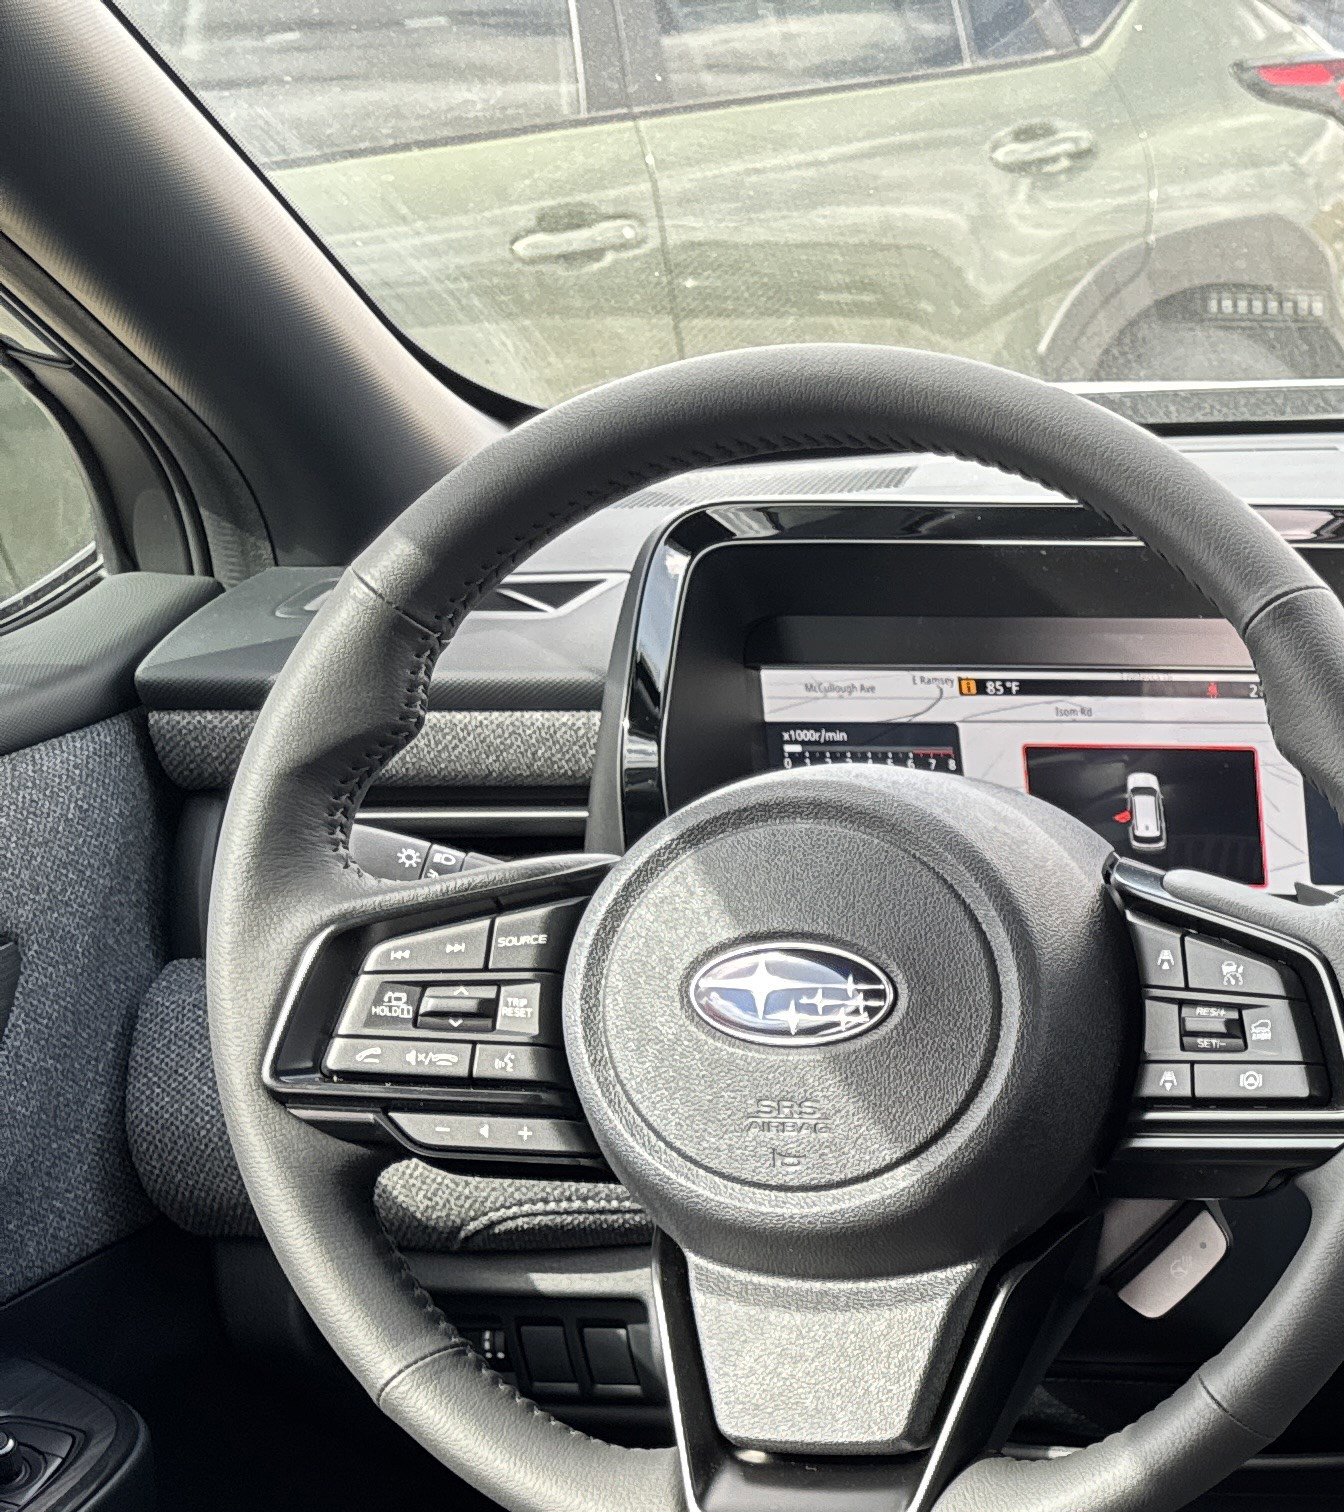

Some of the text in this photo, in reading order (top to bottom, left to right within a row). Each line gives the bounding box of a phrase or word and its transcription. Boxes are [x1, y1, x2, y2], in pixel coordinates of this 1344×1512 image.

[860, 684, 876, 694] Ave
[985, 680, 1020, 695] 85°F
[782, 729, 848, 742] x1000r/min
[784, 757, 793, 769] 0
[497, 934, 548, 948] SOURCE
[501, 1008, 533, 1018] RESET
[756, 1099, 821, 1117] SRS
